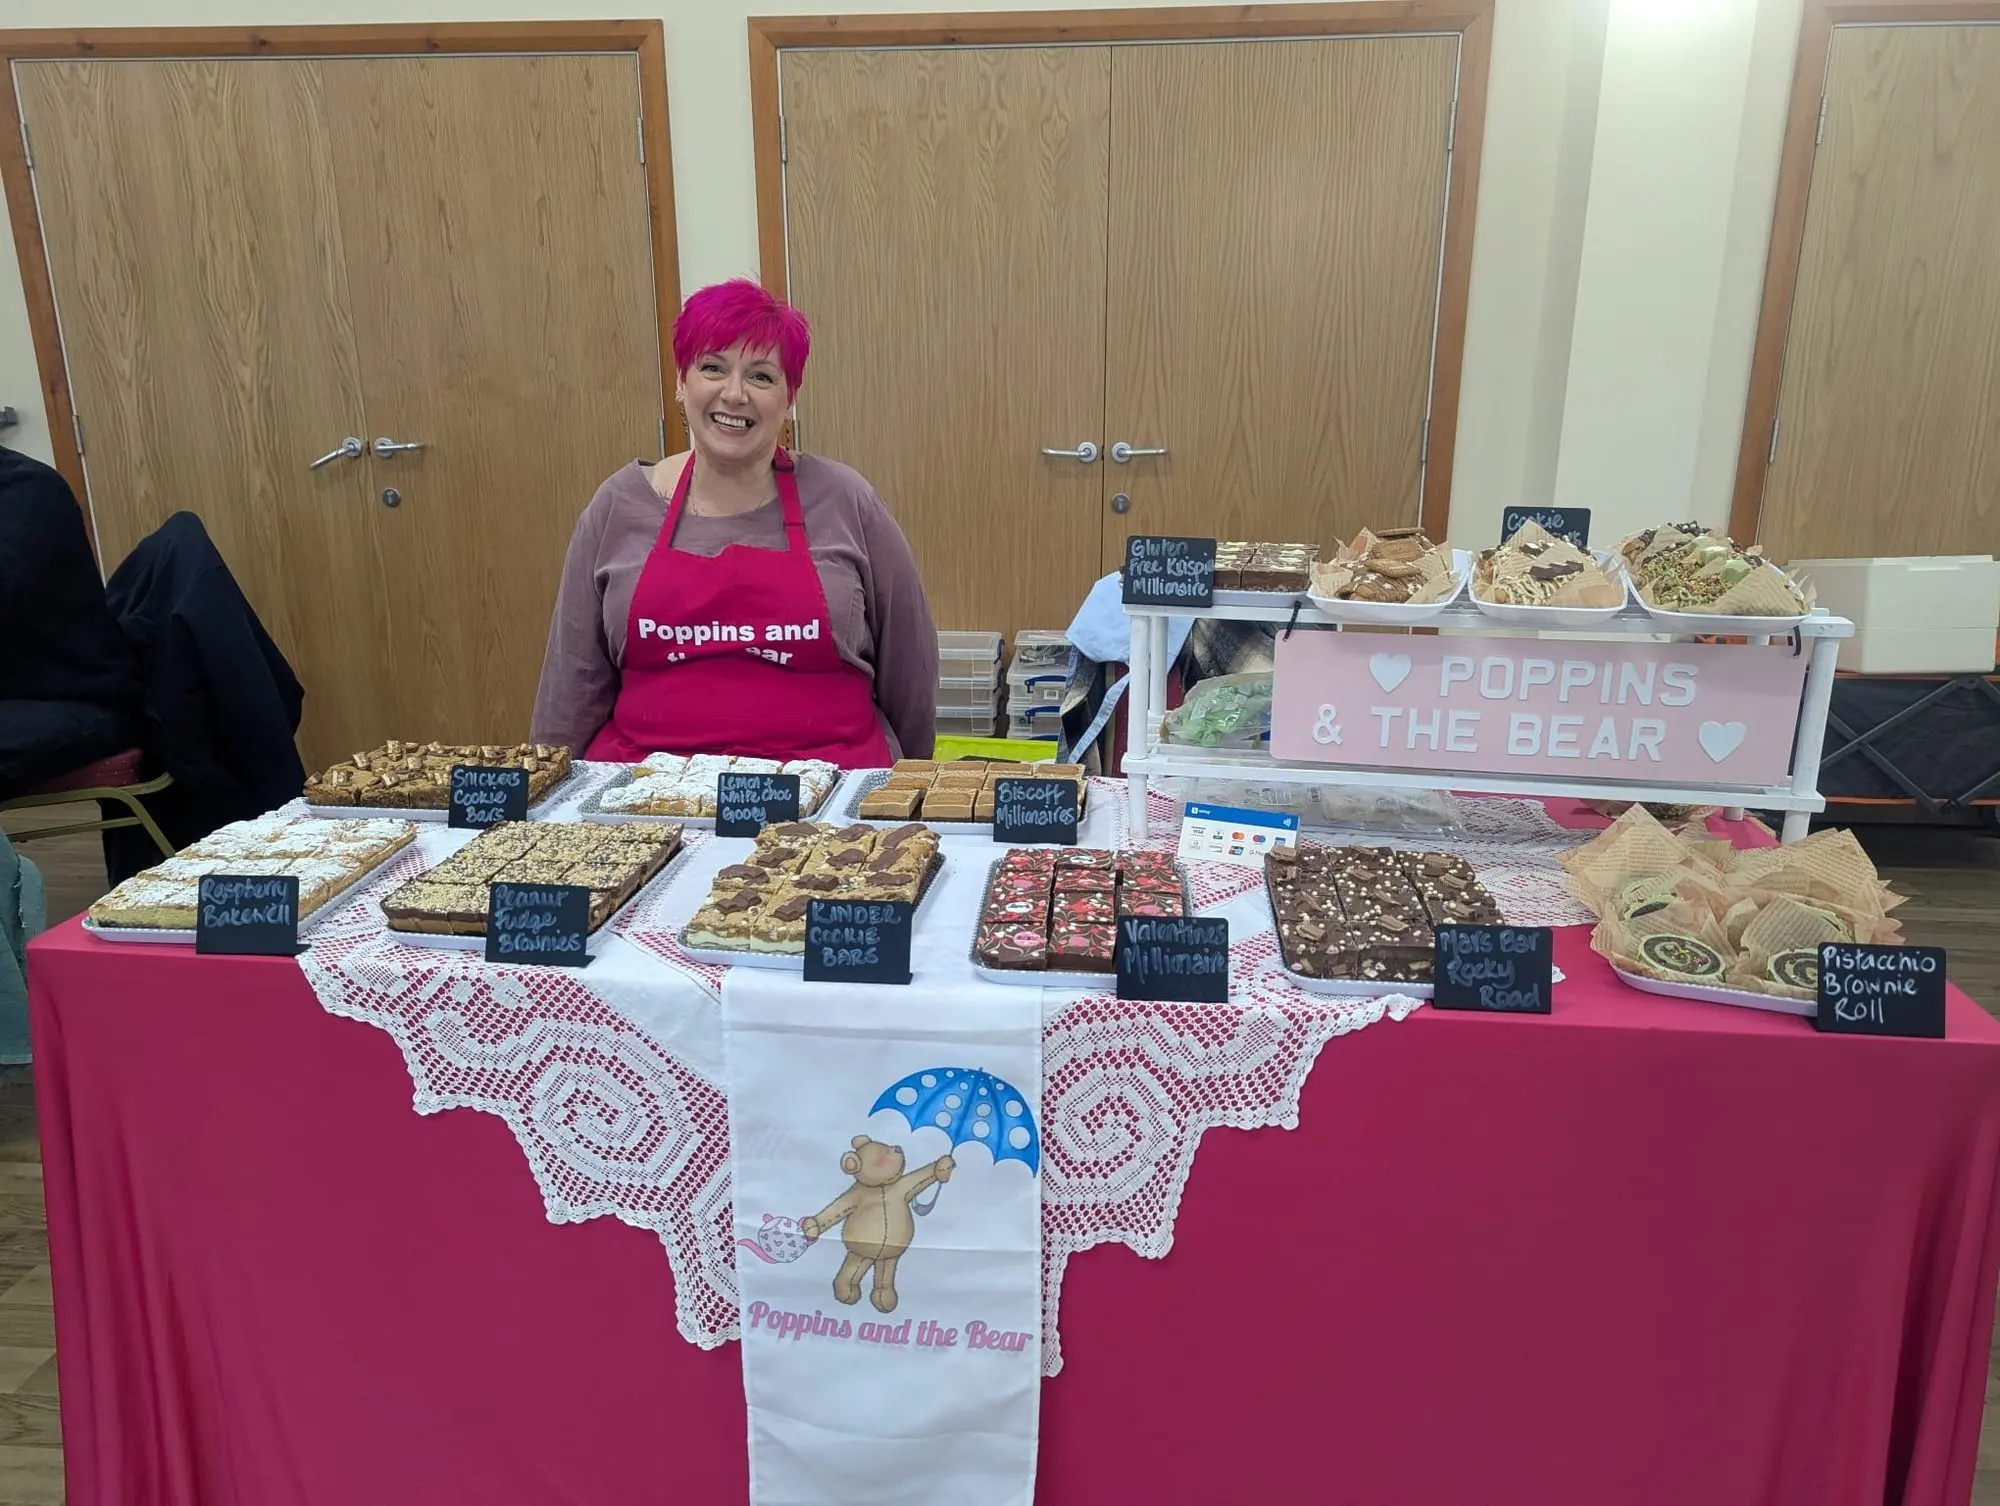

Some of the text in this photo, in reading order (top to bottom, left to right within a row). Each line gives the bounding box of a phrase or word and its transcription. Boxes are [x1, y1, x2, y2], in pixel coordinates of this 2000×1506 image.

[1131, 539, 1188, 557] Gluten
[1129, 557, 1162, 576] Free
[638, 618, 820, 646] Poppins and
[745, 647, 793, 665] ear
[1439, 655, 1698, 706] POPPINS
[1312, 703, 1667, 762] & THE BEAR
[721, 775, 760, 791] Lemon
[998, 781, 1065, 804] Biscoff
[453, 786, 507, 806] Cookie
[466, 805, 504, 823] Bars
[722, 806, 766, 823] Gooey
[201, 878, 288, 905] Raspberry
[495, 884, 569, 909] Peanut
[495, 907, 556, 934] Fudge
[812, 901, 901, 924] KINDER
[498, 929, 581, 953] Brownies
[810, 926, 880, 946] COOKIE
[1124, 919, 1226, 946] Valentines
[1440, 928, 1540, 959] Mars Bar
[822, 946, 879, 967] BARS
[1822, 945, 1936, 972] Pistacchio
[1446, 957, 1516, 989] Rocky
[1823, 972, 1919, 995] Brownie
[1479, 982, 1540, 1009] Road
[1834, 997, 1884, 1024] Roll
[748, 1300, 1034, 1352] Poppins and the Bear
